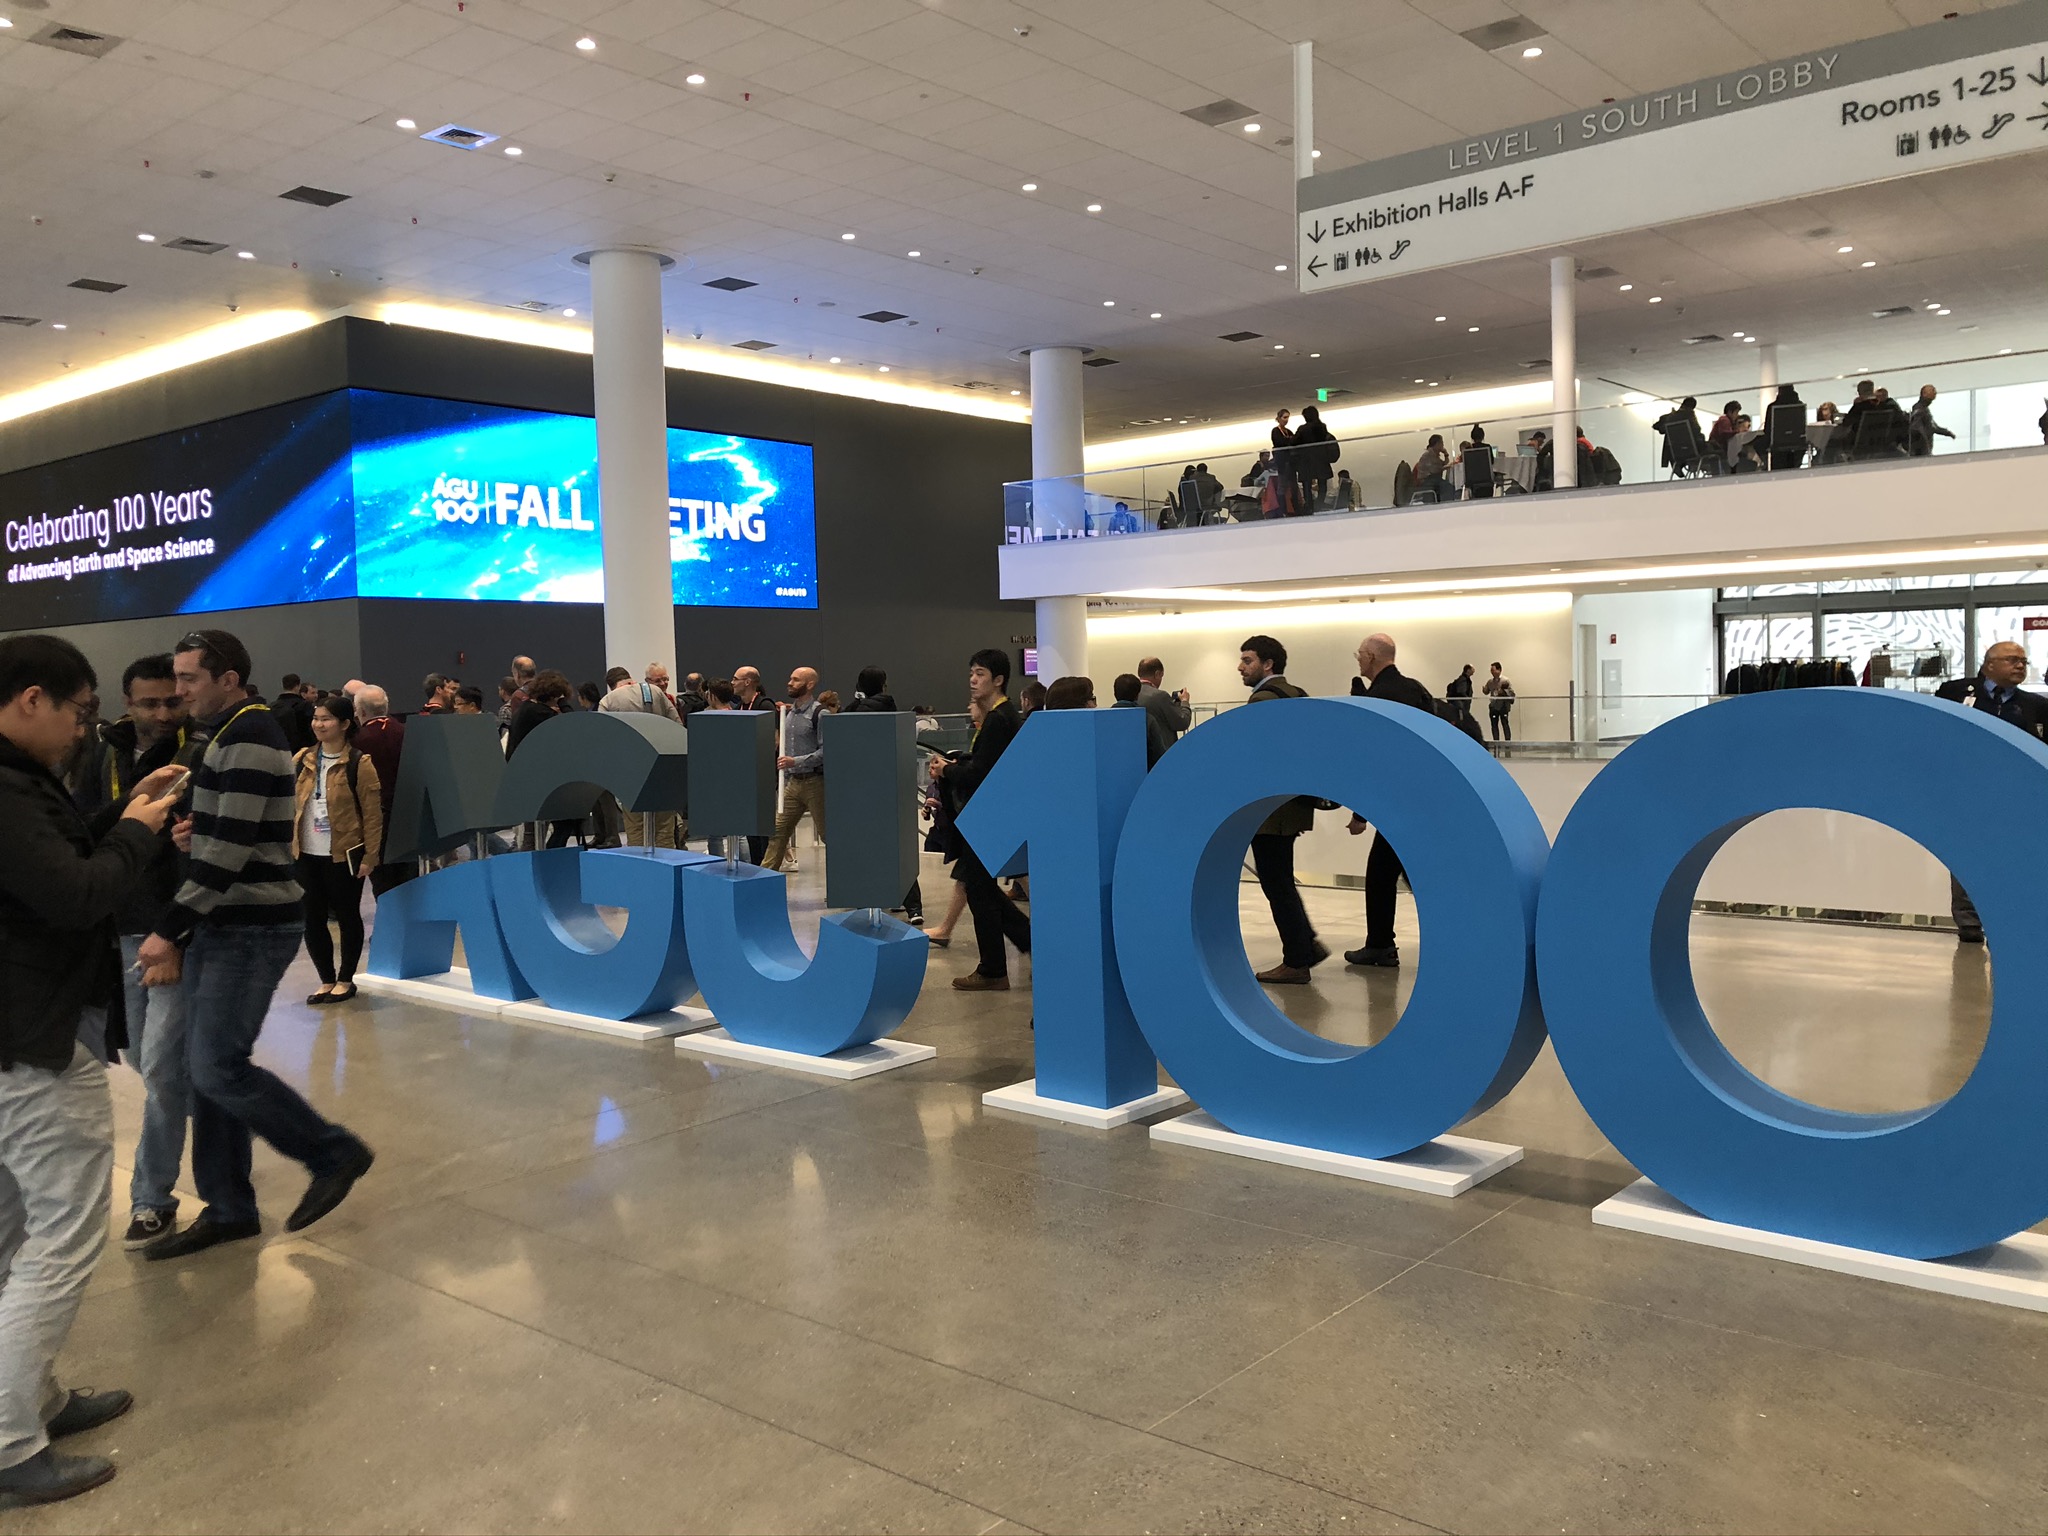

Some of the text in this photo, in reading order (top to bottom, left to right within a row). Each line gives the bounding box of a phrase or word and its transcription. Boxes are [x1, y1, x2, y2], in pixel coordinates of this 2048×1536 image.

[1449, 53, 1839, 170] LEVEL 1 SOUTH LOBBY
[1841, 65, 2017, 126] Rooms 1-25
[1332, 173, 1535, 238] Exhibition Halls A-F
[5, 487, 213, 553] Celebrating 100 Years
[431, 477, 479, 501] AGU
[431, 499, 480, 525] 100
[494, 481, 767, 543] FALL ETING
[7, 536, 215, 584] of Advancing Earth and Space Science
[366, 687, 2048, 1260] AGU 100
